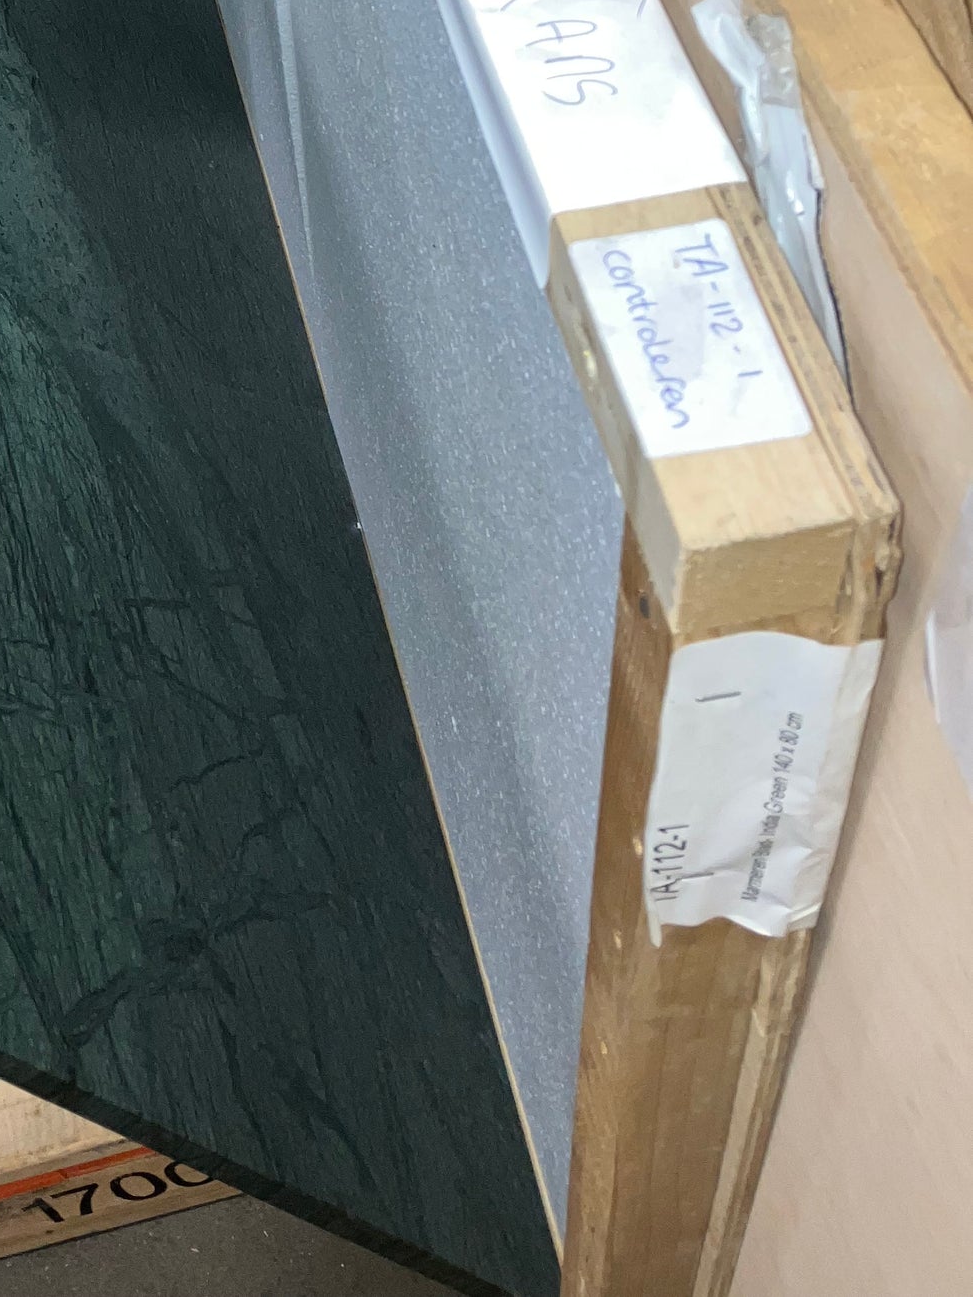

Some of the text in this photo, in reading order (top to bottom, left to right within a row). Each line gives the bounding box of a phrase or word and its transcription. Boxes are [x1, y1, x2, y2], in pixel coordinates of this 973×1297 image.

[786, 711, 804, 730] cm
[771, 753, 794, 774] 140
[763, 775, 788, 814] Green
